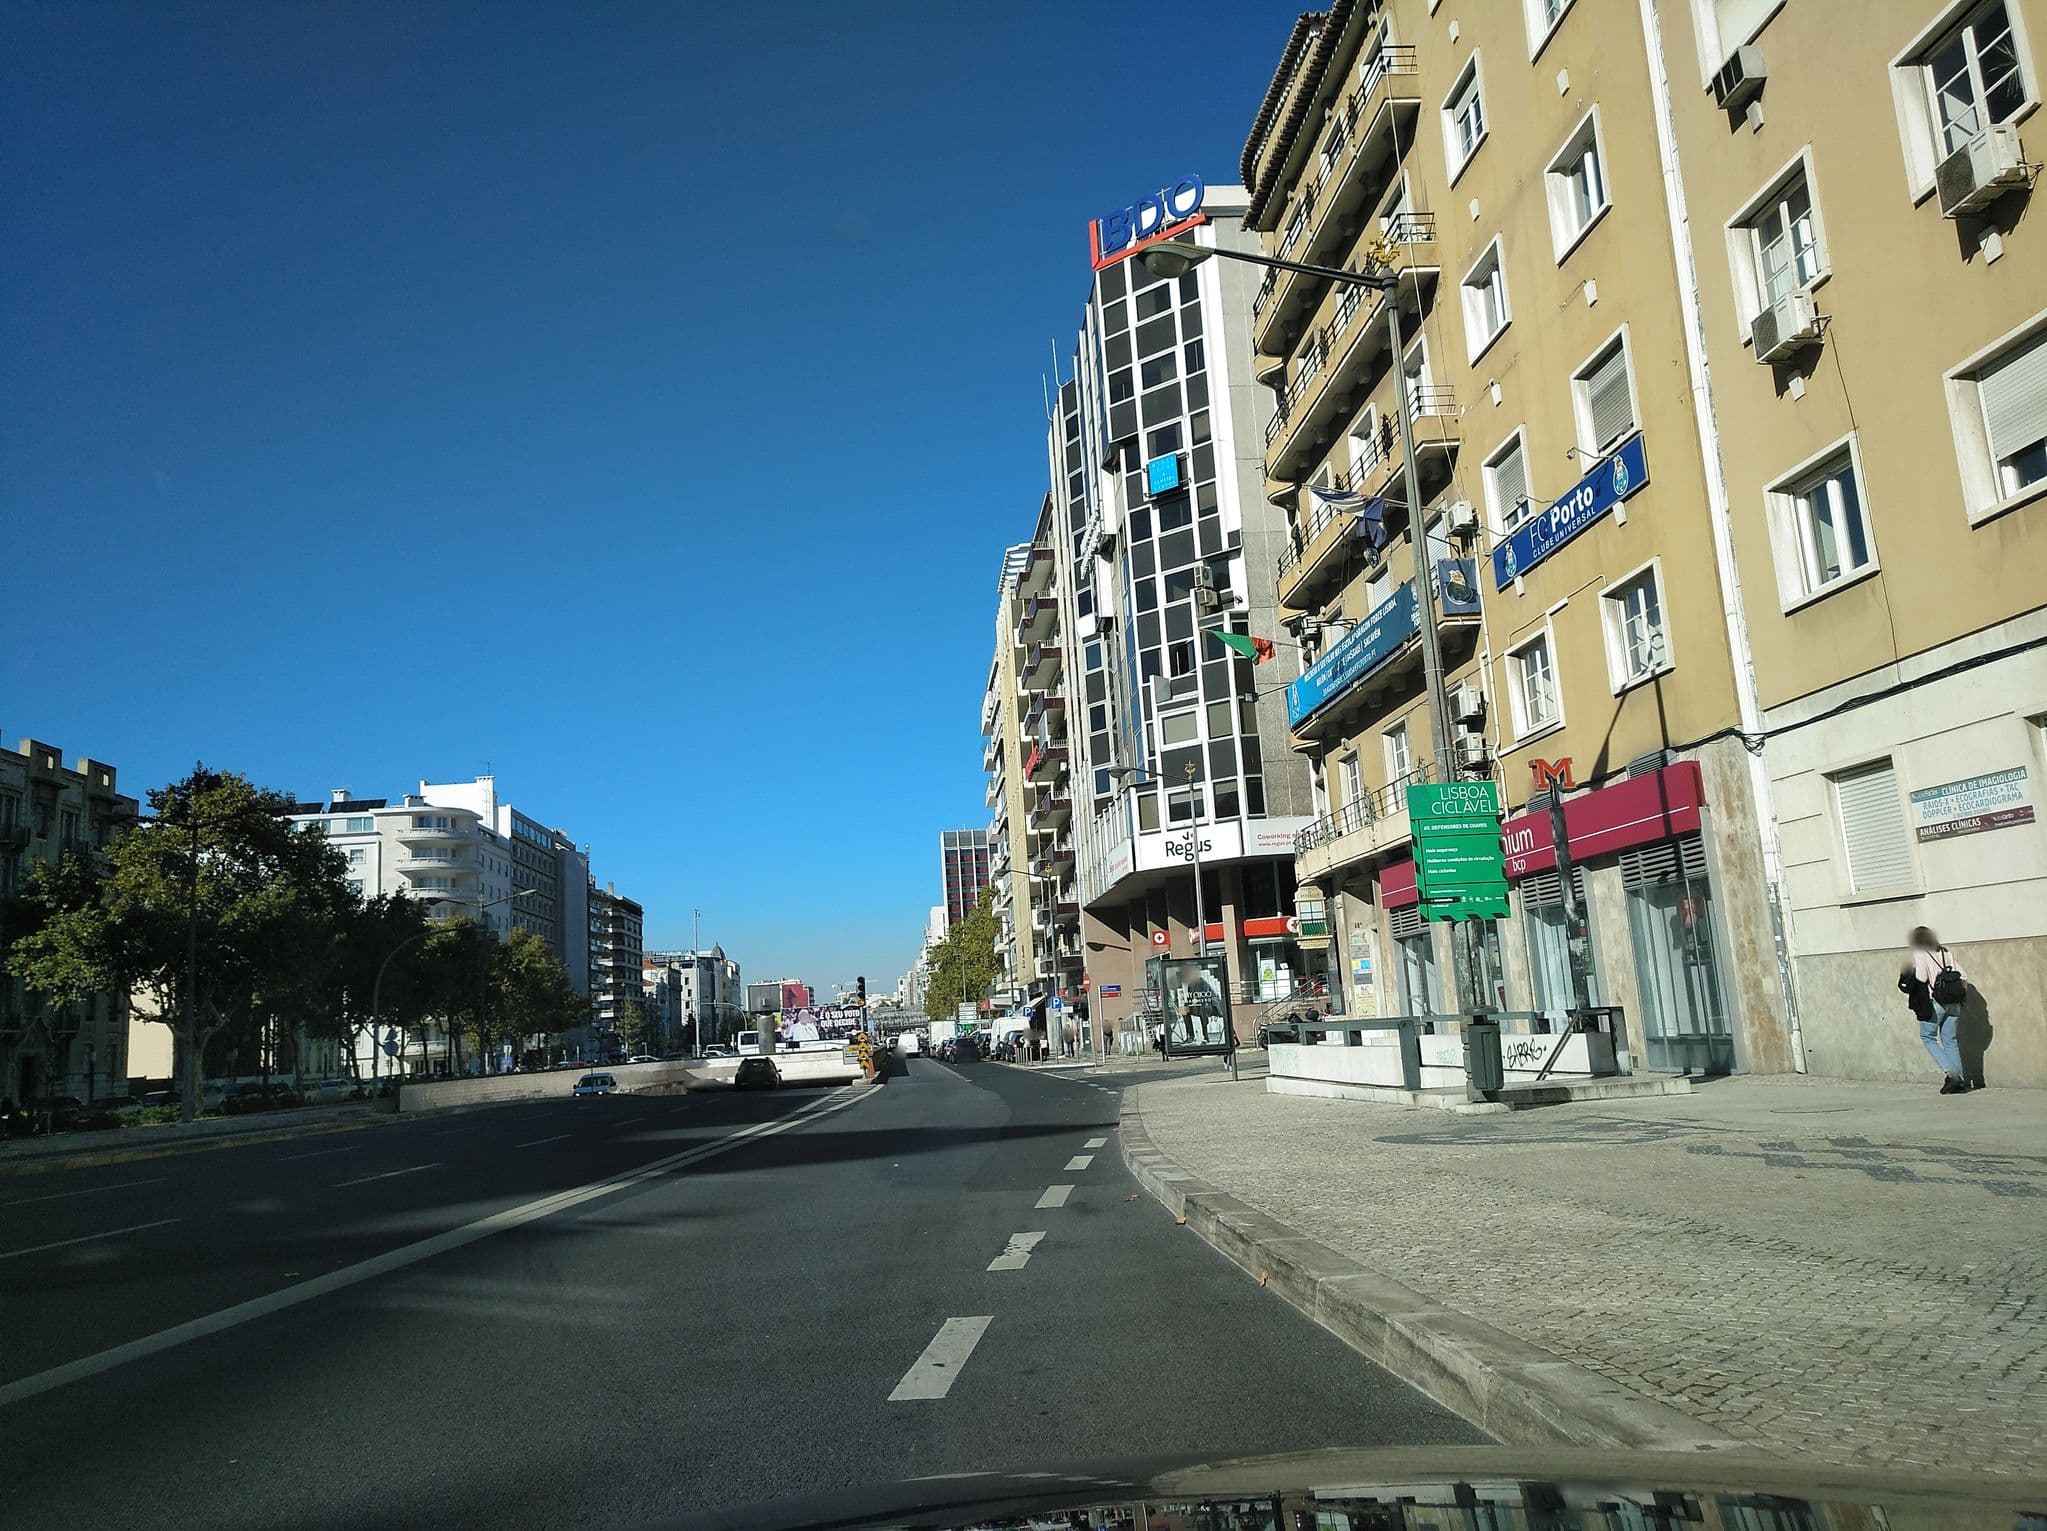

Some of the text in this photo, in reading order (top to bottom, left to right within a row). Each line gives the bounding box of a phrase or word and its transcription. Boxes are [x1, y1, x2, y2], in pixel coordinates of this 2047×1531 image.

[1102, 176, 1204, 251] BDO
[1529, 486, 1594, 549] FC Porto
[1532, 507, 1596, 558] CLUBE UNIVERSAL
[1528, 757, 1576, 789] M
[1942, 783, 1967, 796] CLÍNICA
[1968, 780, 1978, 790] DE
[1979, 769, 2026, 789] IMAGIOLOGIA
[1440, 786, 1489, 800] LISBOA
[1923, 782, 2020, 810] RAIOS-X ECOGRAFIAS TAC
[1431, 798, 1497, 815] CICLÁVEL
[1922, 806, 1952, 819] DOPPLER
[1958, 791, 2024, 812] ECOCARDIOGRAMA
[1257, 832, 1292, 841] Coworking
[1919, 822, 1950, 837] ANÁLISES
[1951, 816, 1982, 831] CLÍNICAS
[1165, 838, 1212, 862] Regus
[1512, 858, 1526, 874] bcp
[1024, 1007, 1031, 1016] P
[1053, 997, 1060, 1008] P
[820, 1018, 856, 1028] QUE DECIDE
[825, 1011, 830, 1019] O
